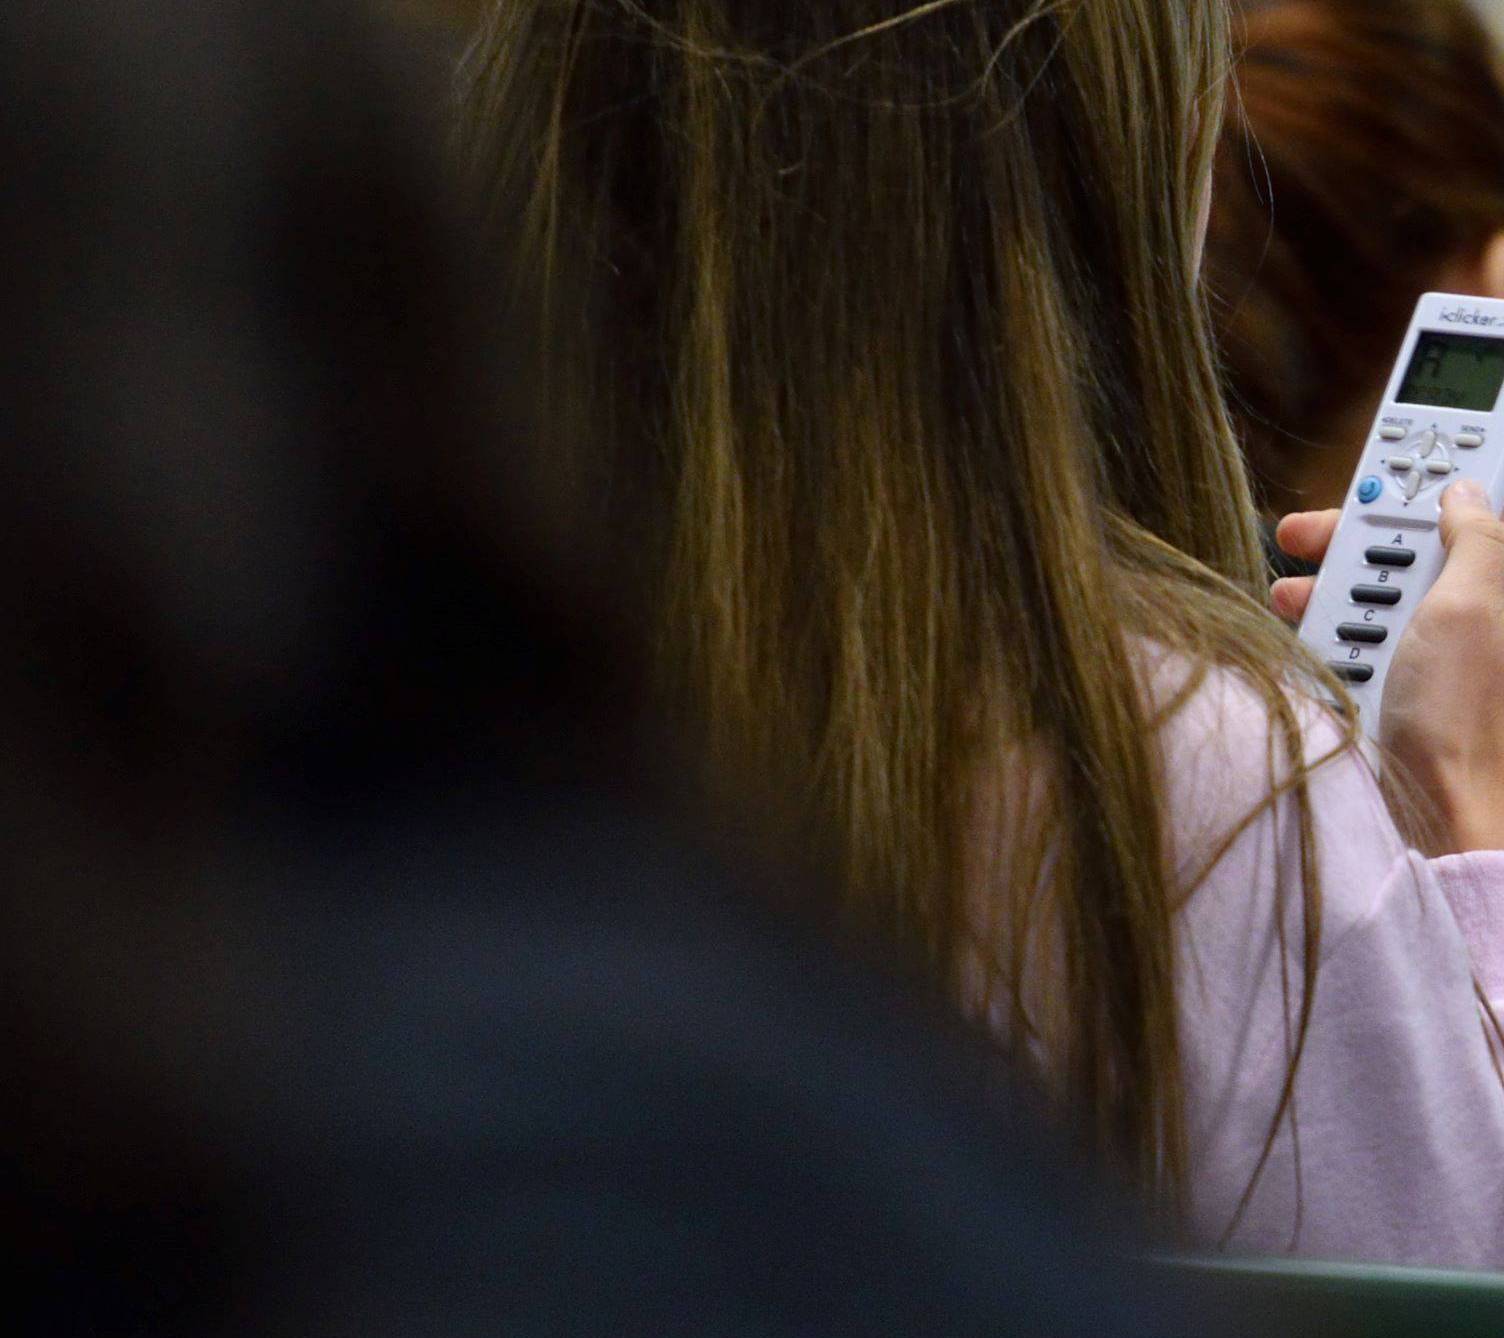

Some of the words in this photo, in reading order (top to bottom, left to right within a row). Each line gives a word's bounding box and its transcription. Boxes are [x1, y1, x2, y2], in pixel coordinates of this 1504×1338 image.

[1391, 533, 1402, 545] A
[1378, 570, 1389, 582] B
[1364, 609, 1375, 621] C
[1349, 647, 1360, 659] D
